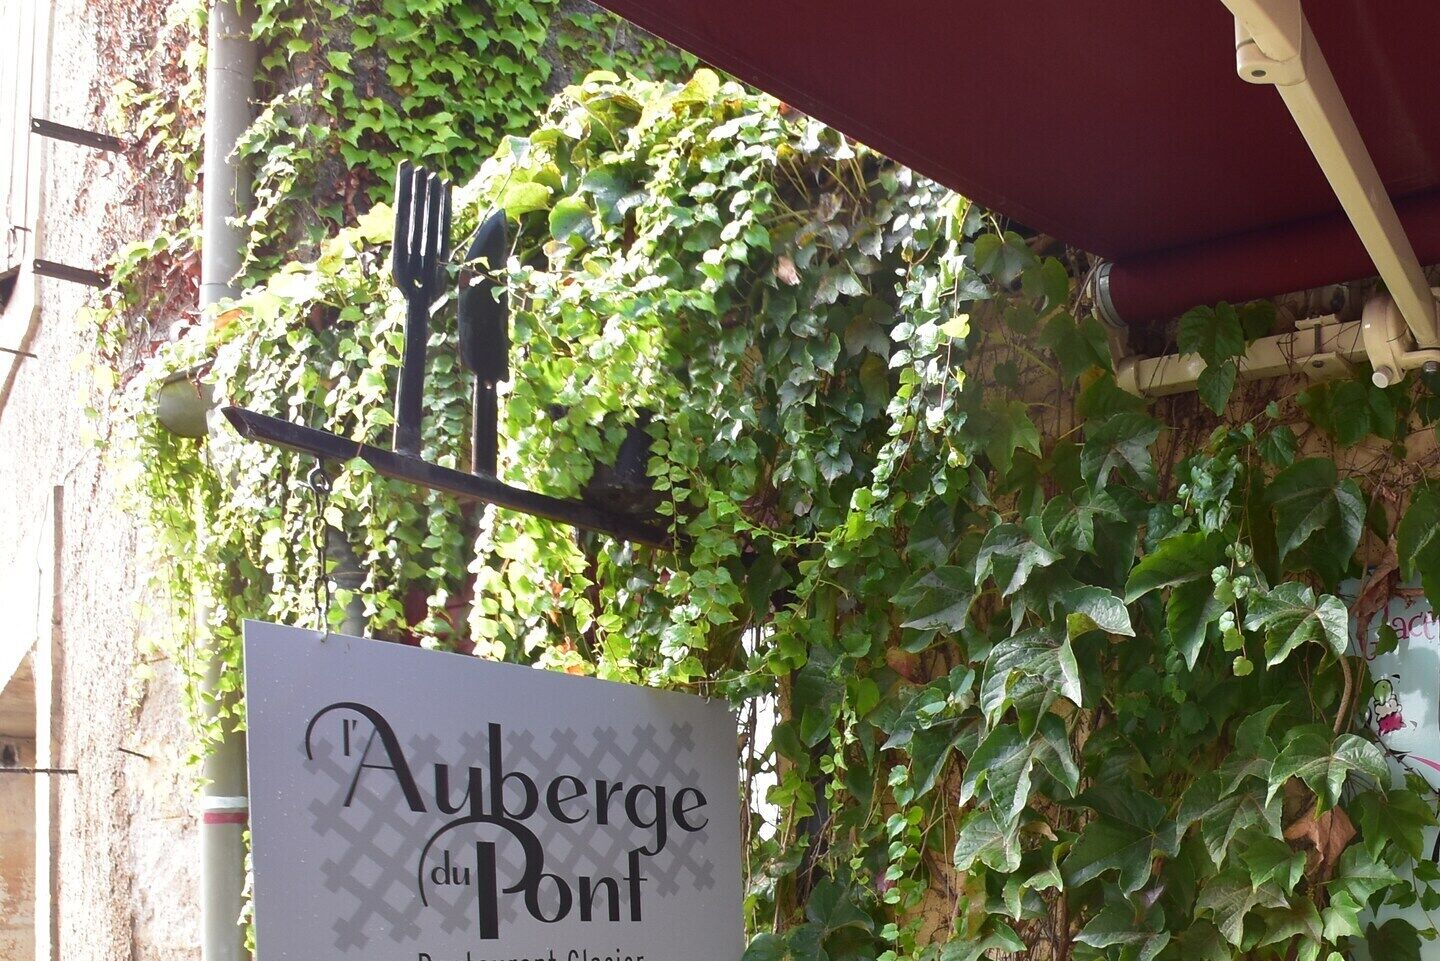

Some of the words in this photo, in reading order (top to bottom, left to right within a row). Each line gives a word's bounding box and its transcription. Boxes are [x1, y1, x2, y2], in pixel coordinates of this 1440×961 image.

[305, 701, 709, 857] l'Auberge
[419, 814, 648, 940] Pont
[431, 849, 471, 886] du
